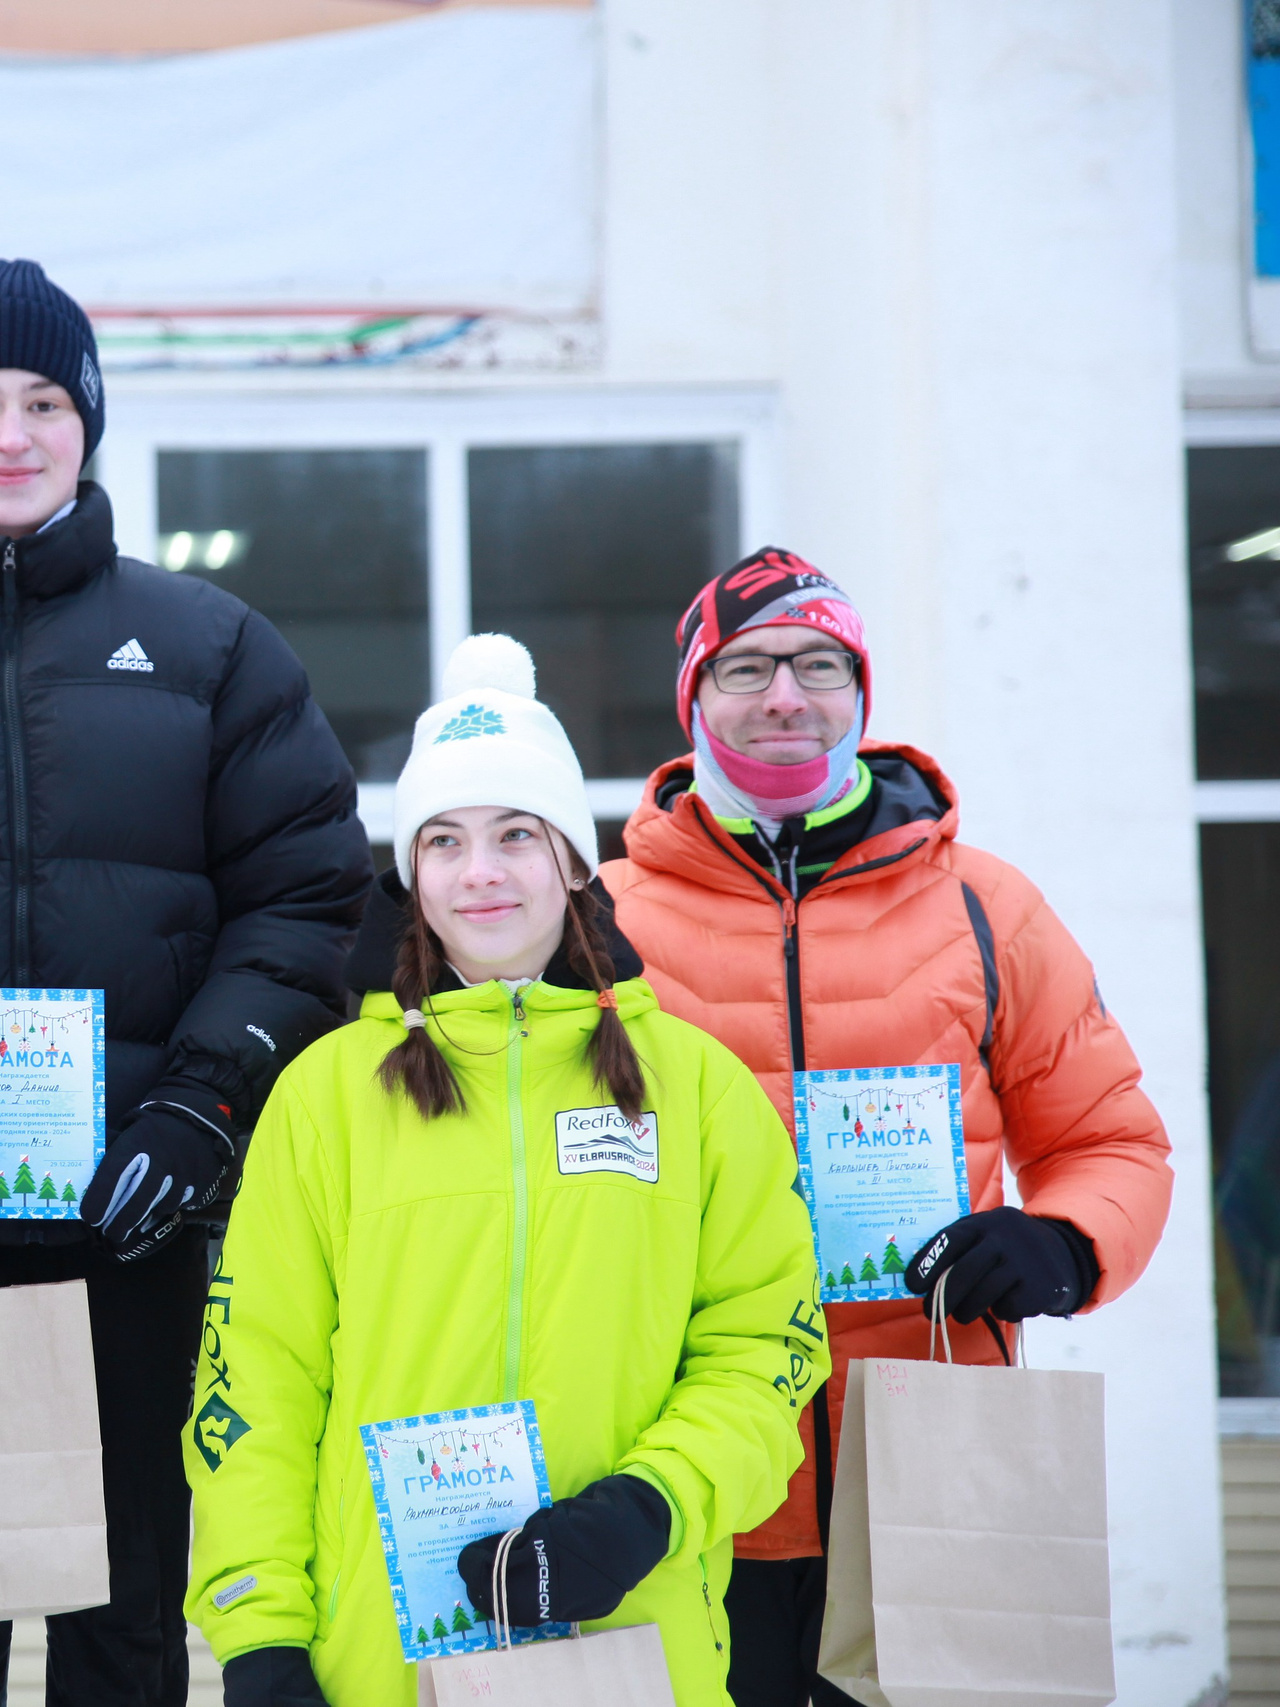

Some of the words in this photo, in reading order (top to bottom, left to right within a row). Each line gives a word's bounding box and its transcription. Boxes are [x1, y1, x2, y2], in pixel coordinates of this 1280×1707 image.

[107, 657, 154, 673] adidas
[246, 1024, 276, 1052] adidas
[826, 1128, 932, 1149] ГРАМОТА
[564, 1154, 578, 1164] XV
[636, 1159, 655, 1172] 2024
[881, 1189, 938, 1197] соревнованиях
[887, 1198, 952, 1206] ориентированию
[403, 1465, 514, 1495] ГРАМОТА
[435, 1491, 491, 1502] Награждается
[470, 1517, 497, 1525] МЕСТО
[424, 1536, 464, 1546] городских
[534, 1539, 550, 1619] NORDSKI
